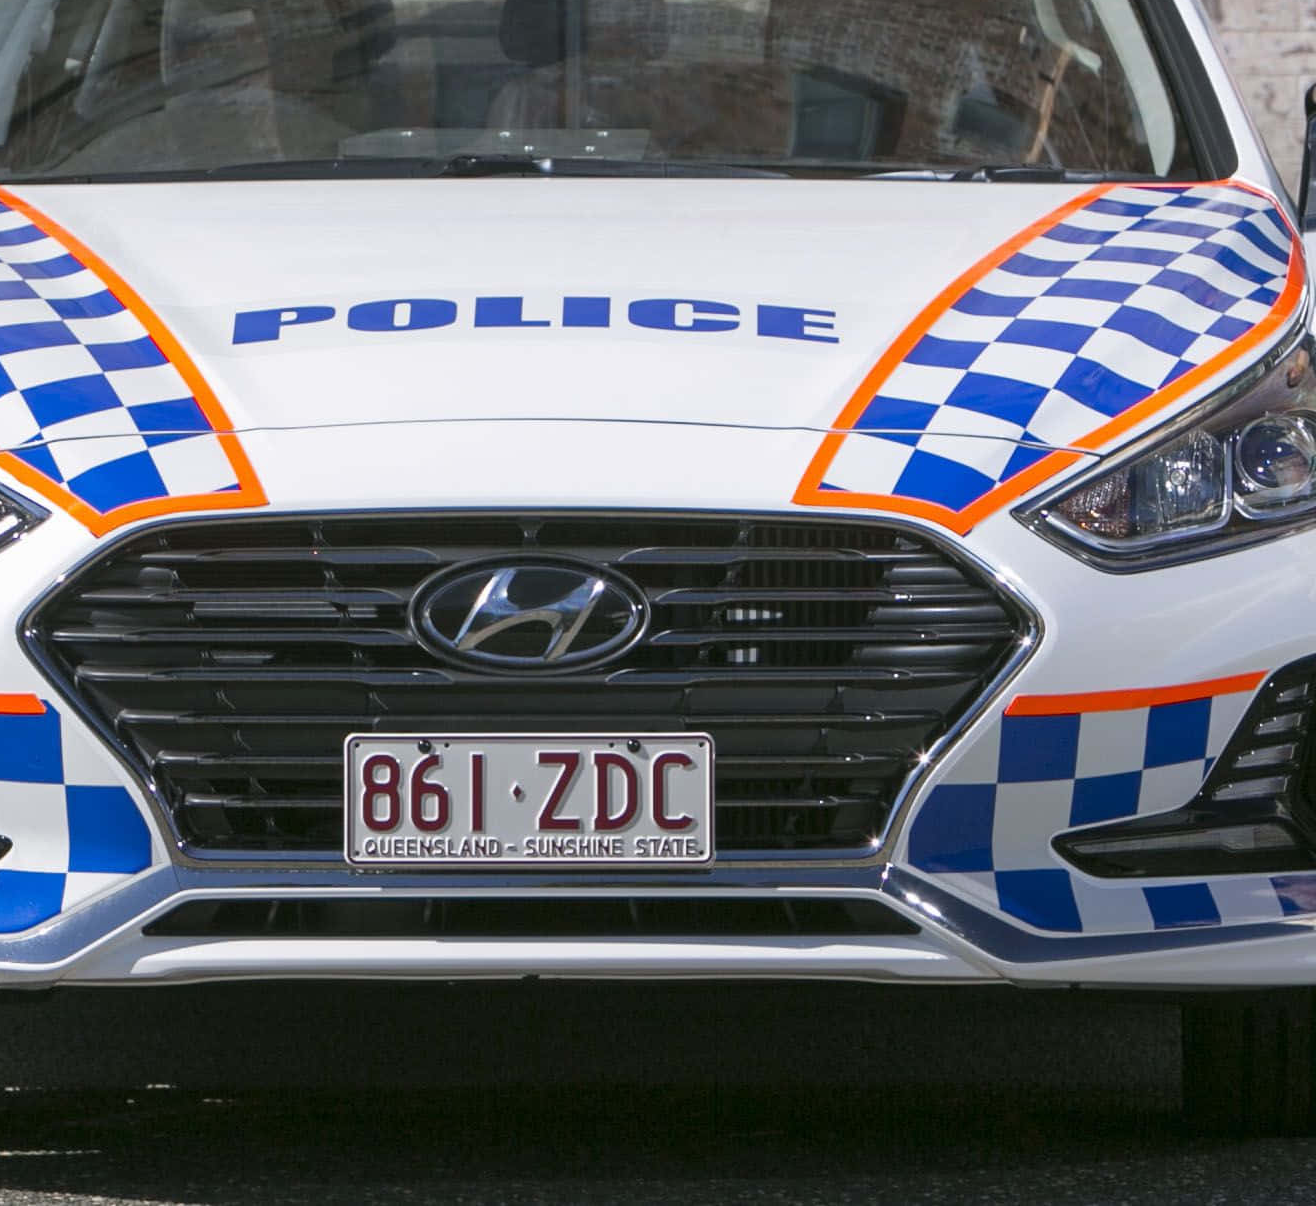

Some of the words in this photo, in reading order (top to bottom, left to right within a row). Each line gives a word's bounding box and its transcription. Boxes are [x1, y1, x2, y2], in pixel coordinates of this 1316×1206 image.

[232, 296, 839, 345] POLICE
[365, 837, 502, 857] QUEENSLAND
[524, 837, 623, 857] SUNSHINE
[634, 837, 698, 857] STATE
